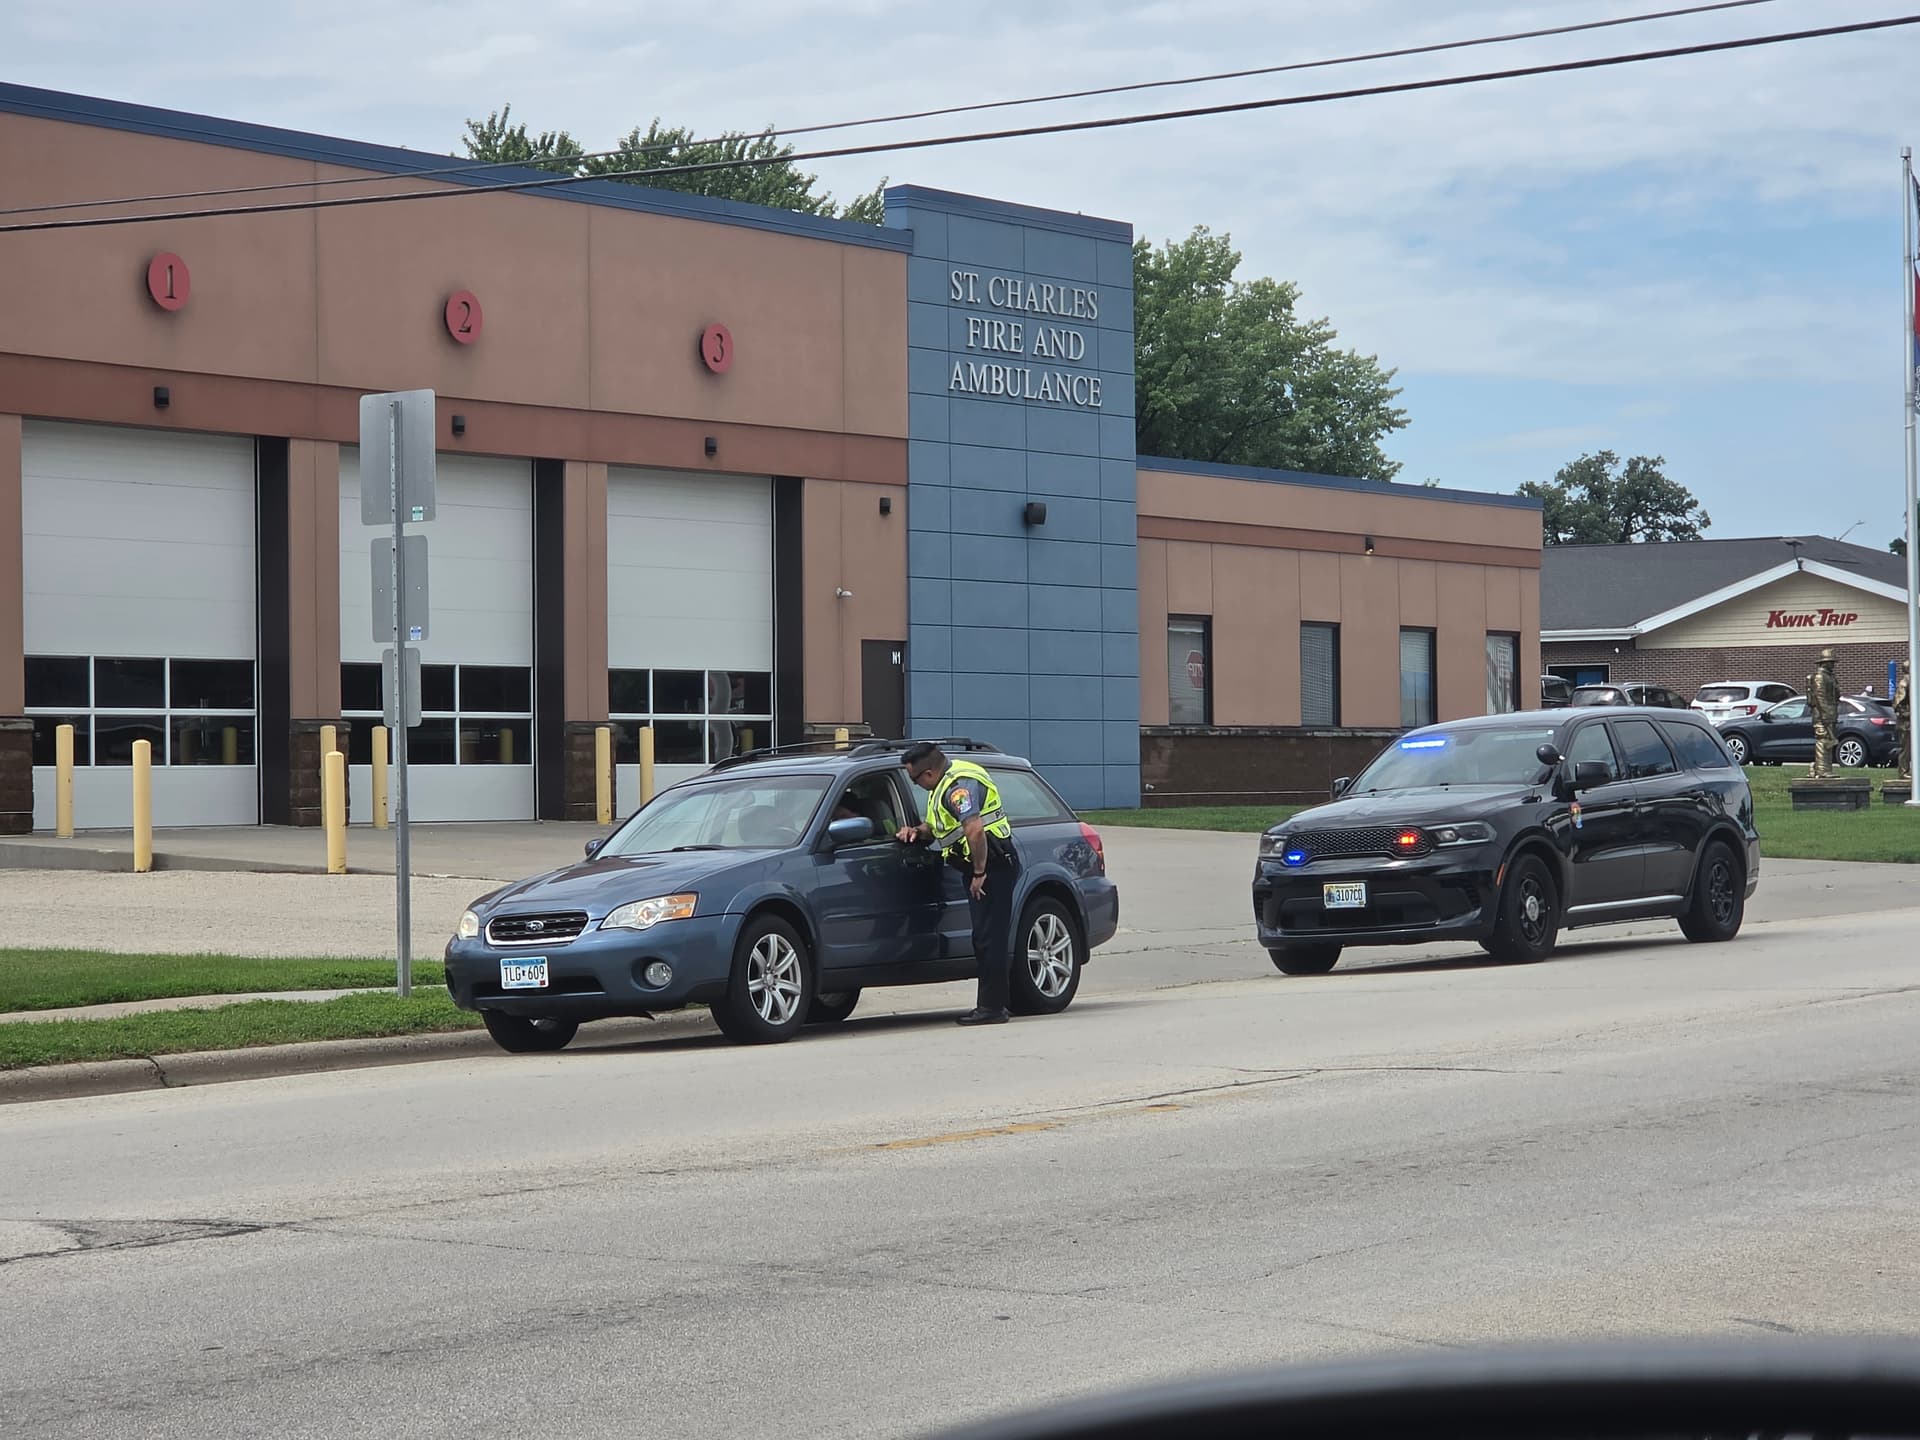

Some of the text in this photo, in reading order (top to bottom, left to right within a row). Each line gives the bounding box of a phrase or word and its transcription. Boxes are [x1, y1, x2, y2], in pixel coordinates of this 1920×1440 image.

[164, 263, 177, 300] 1
[951, 270, 1098, 320] ST. CHARLES
[457, 300, 473, 334] 2
[712, 332, 725, 364] 3
[967, 317, 1085, 361] FIRE AND
[949, 361, 1103, 407] AMBULANCE
